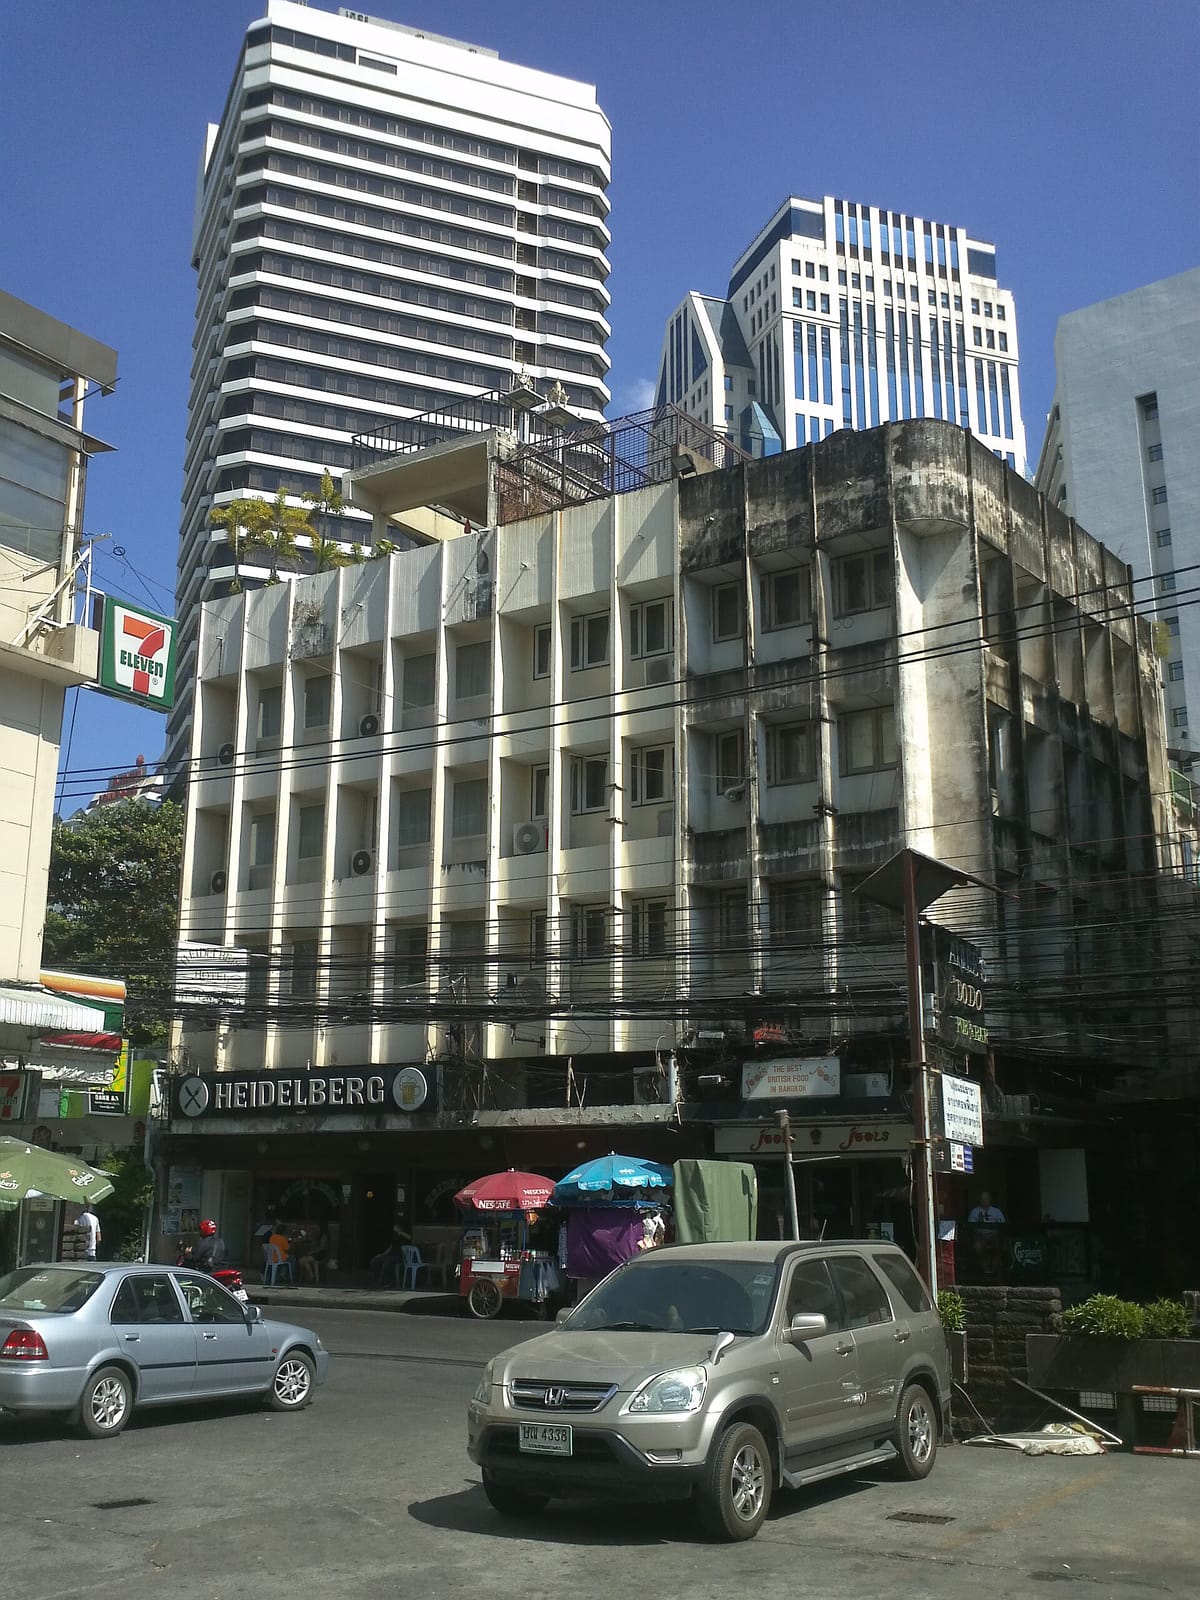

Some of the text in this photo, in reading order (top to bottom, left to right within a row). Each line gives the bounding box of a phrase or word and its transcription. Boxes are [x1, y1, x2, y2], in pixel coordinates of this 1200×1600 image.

[123, 614, 165, 696] 7
[773, 1064, 803, 1073] THE BEST
[768, 1074, 809, 1083] BRITISH FOOD
[215, 1076, 385, 1109] HEIDELBERG
[779, 1085, 807, 1093] BANGKOK
[541, 1428, 567, 1442] 4338
